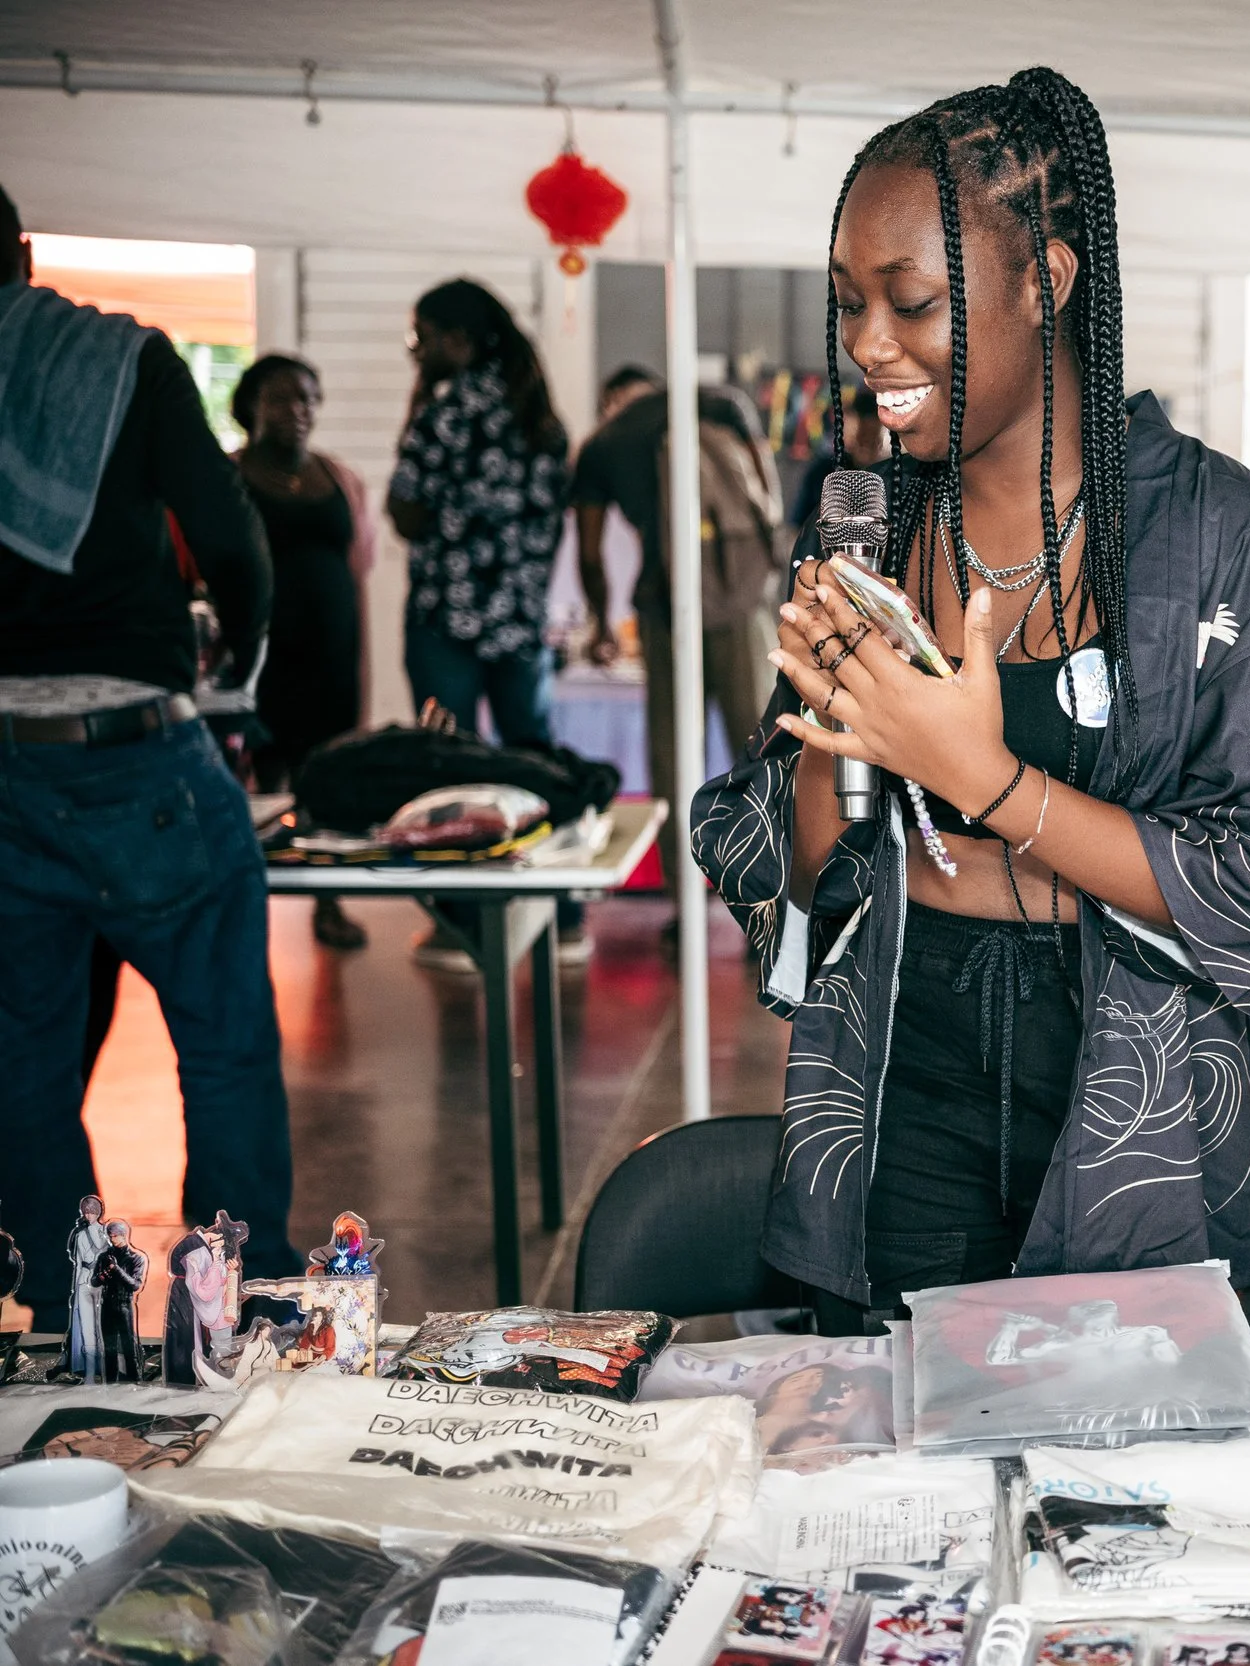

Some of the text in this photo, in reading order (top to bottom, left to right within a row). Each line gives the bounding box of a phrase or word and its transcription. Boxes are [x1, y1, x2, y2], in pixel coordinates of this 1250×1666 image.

[386, 1380, 659, 1433] DAECHWITA
[368, 1414, 648, 1458] DAECHWITA
[348, 1447, 633, 1480] DAECHWITA
